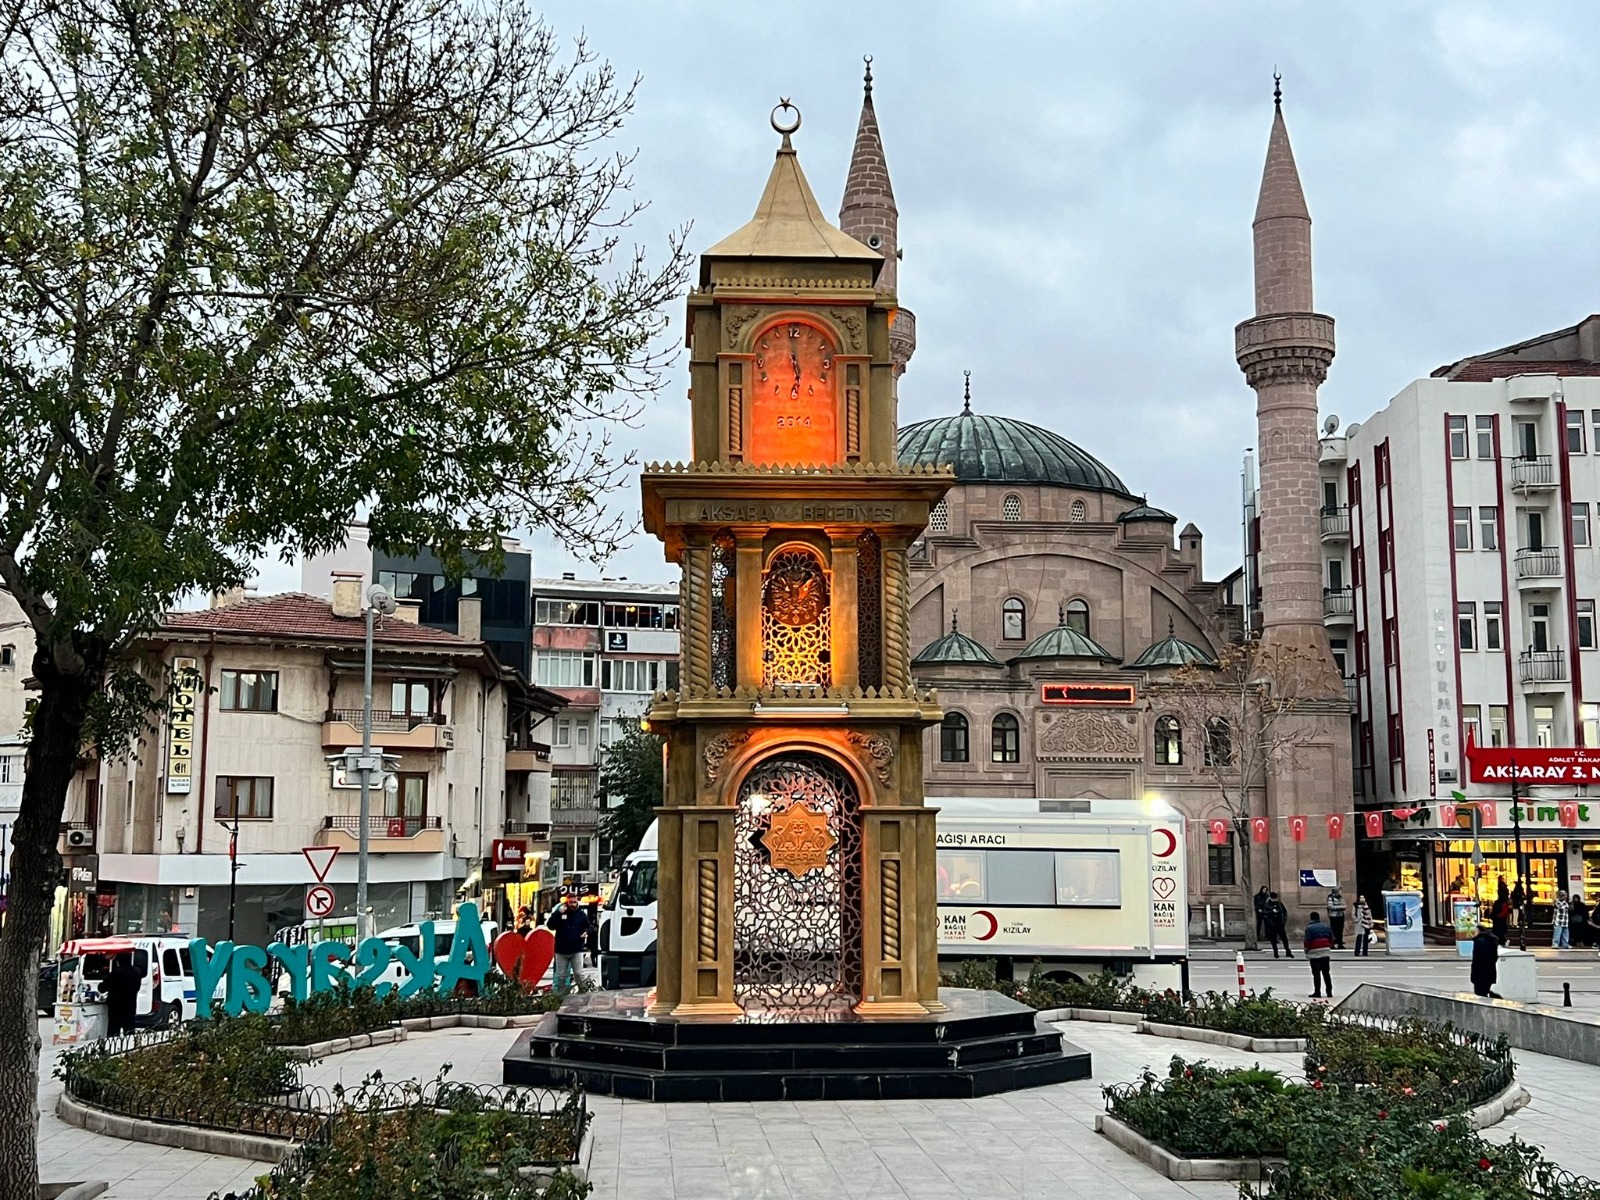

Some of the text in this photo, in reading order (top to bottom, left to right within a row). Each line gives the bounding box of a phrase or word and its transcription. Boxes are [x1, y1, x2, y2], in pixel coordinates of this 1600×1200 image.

[787, 327, 800, 338] 12
[757, 358, 764, 368] 9
[823, 359, 830, 369] 3
[791, 389, 798, 400] 6
[777, 416, 812, 428] 2014
[699, 503, 897, 522] AKSARAY BELEDİYESİ
[1434, 608, 1452, 763] KAVURMACI
[1483, 765, 1567, 778] AKSARAY
[1572, 766, 1588, 778] 3.
[1509, 800, 1590, 821] simt
[970, 834, 1006, 845] ARACI
[1153, 902, 1175, 912] KAN
[944, 915, 966, 924] KAN
